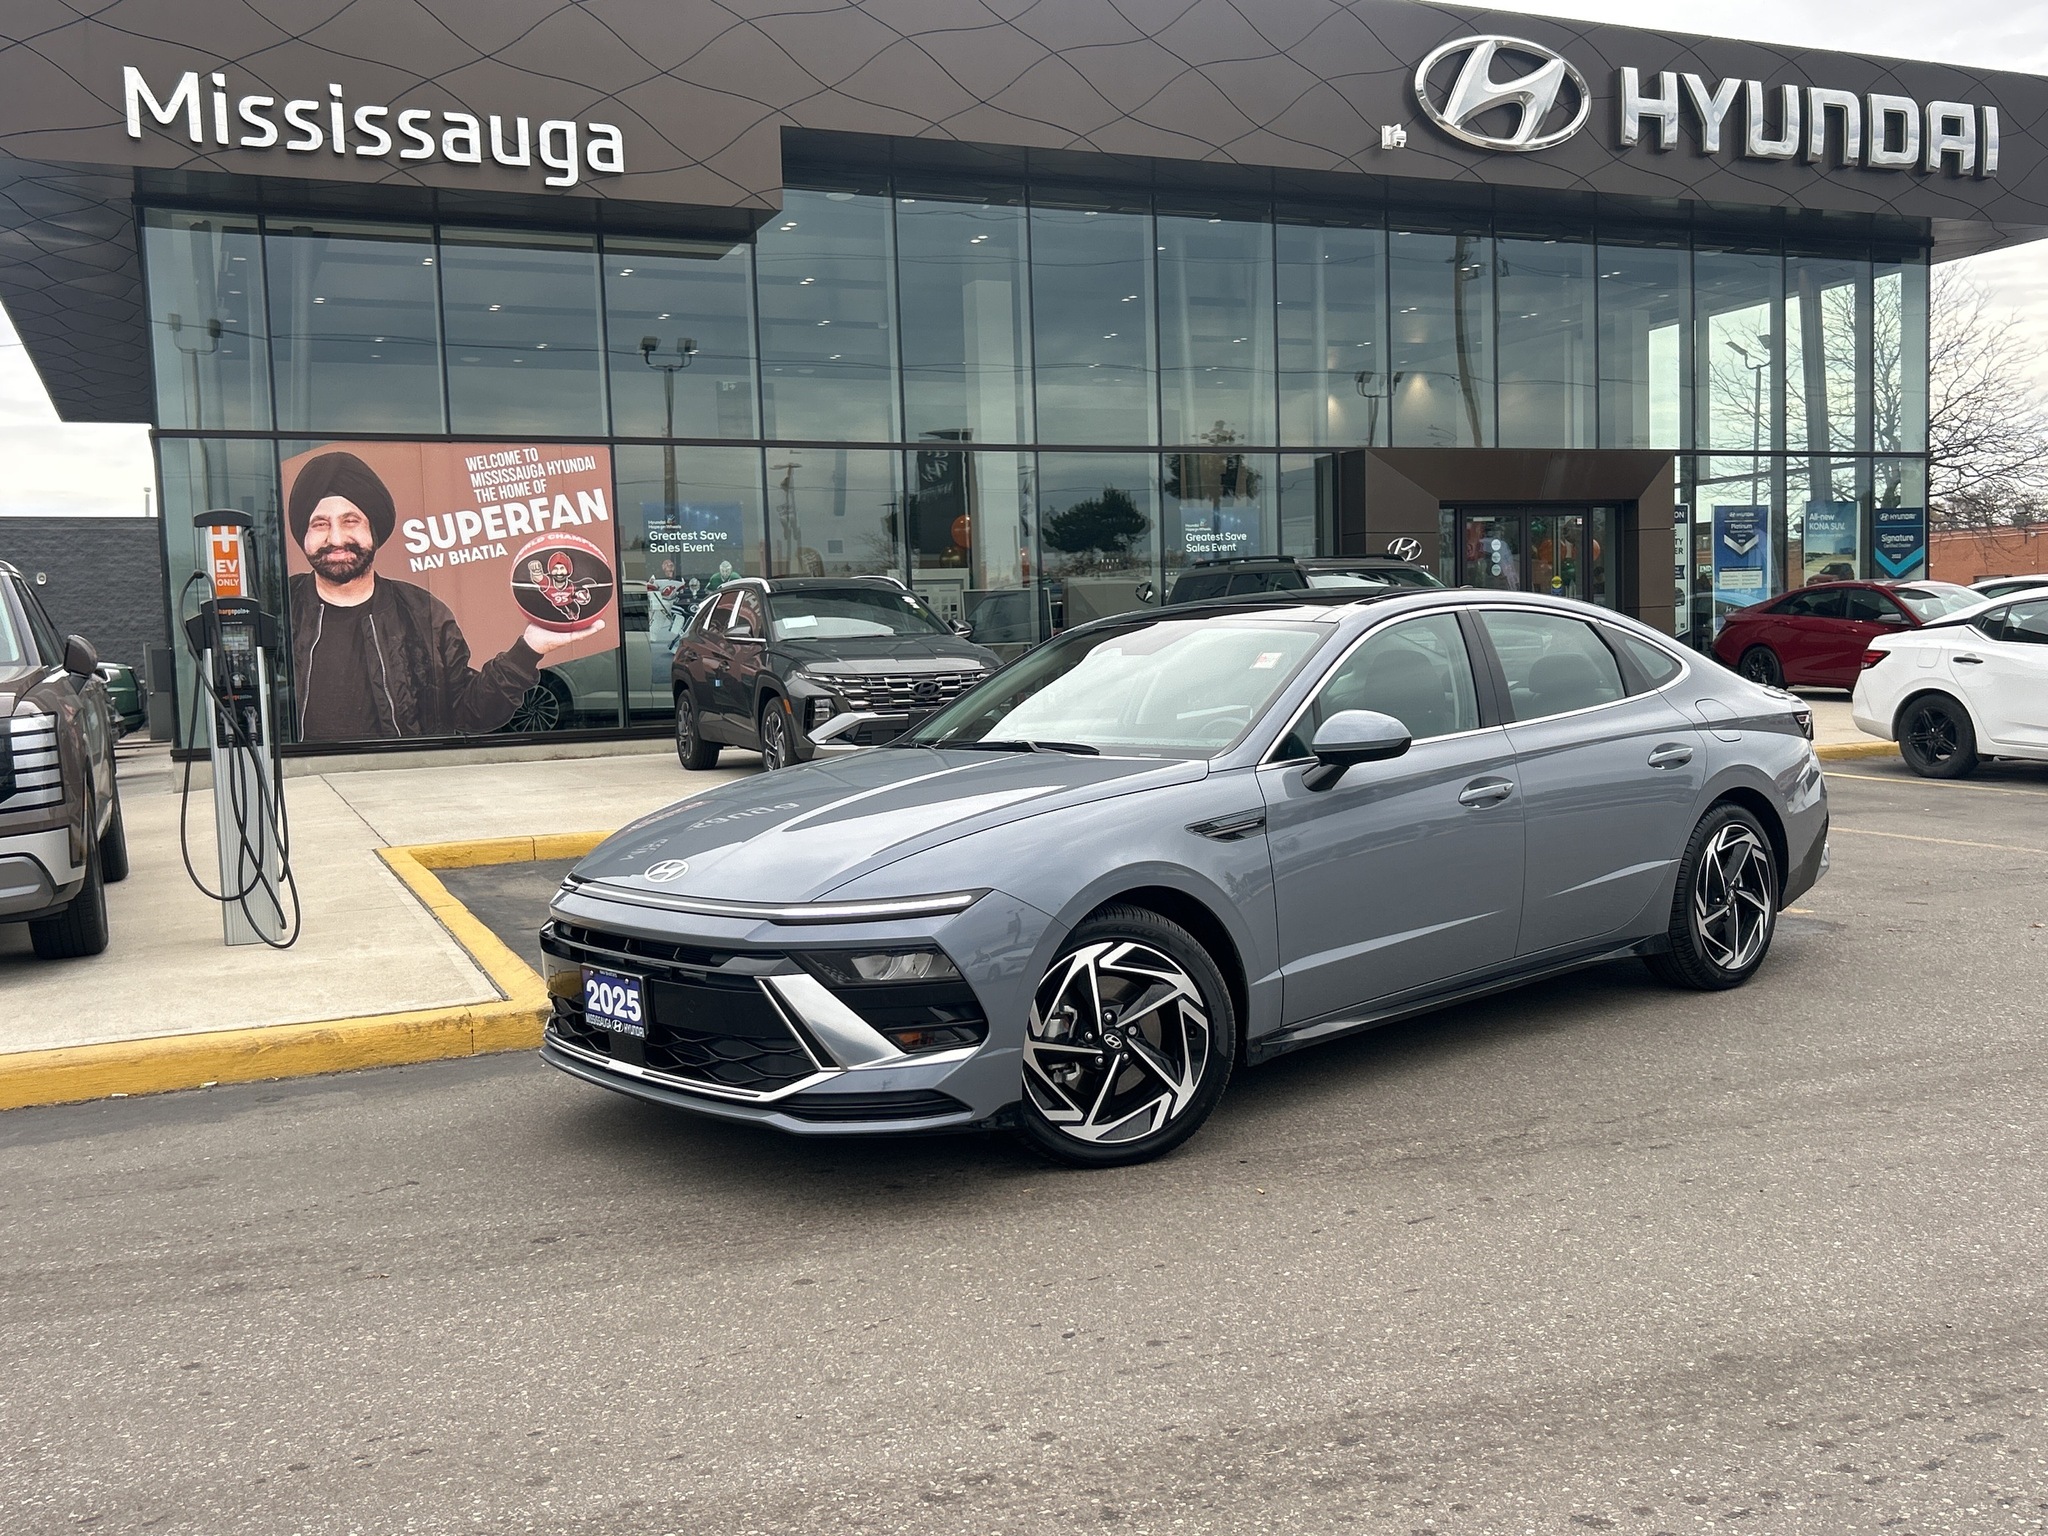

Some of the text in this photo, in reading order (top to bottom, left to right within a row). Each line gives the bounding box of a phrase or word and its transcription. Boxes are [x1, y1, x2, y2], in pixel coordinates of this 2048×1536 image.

[123, 66, 625, 188] Mississauga
[1619, 66, 2000, 179] HYUNDAI
[465, 447, 539, 472] WELCOME TO
[470, 455, 596, 488] MISSISSAUGA HYUNDAI
[473, 479, 548, 503] THE HOME OF
[402, 488, 609, 554] SUPERFAN
[1809, 512, 1835, 520] All-new
[1809, 522, 1829, 530] KONA
[649, 530, 728, 541] Greatest Save
[1185, 532, 1247, 542] Greatest Save
[1881, 534, 1914, 543] Signature
[650, 543, 715, 553] Sales Event
[1186, 543, 1237, 552] Sales Event
[409, 543, 508, 573] NAV BHATIA
[216, 559, 238, 573] EV
[217, 579, 240, 587] ONLY
[586, 979, 642, 1022] 2025
